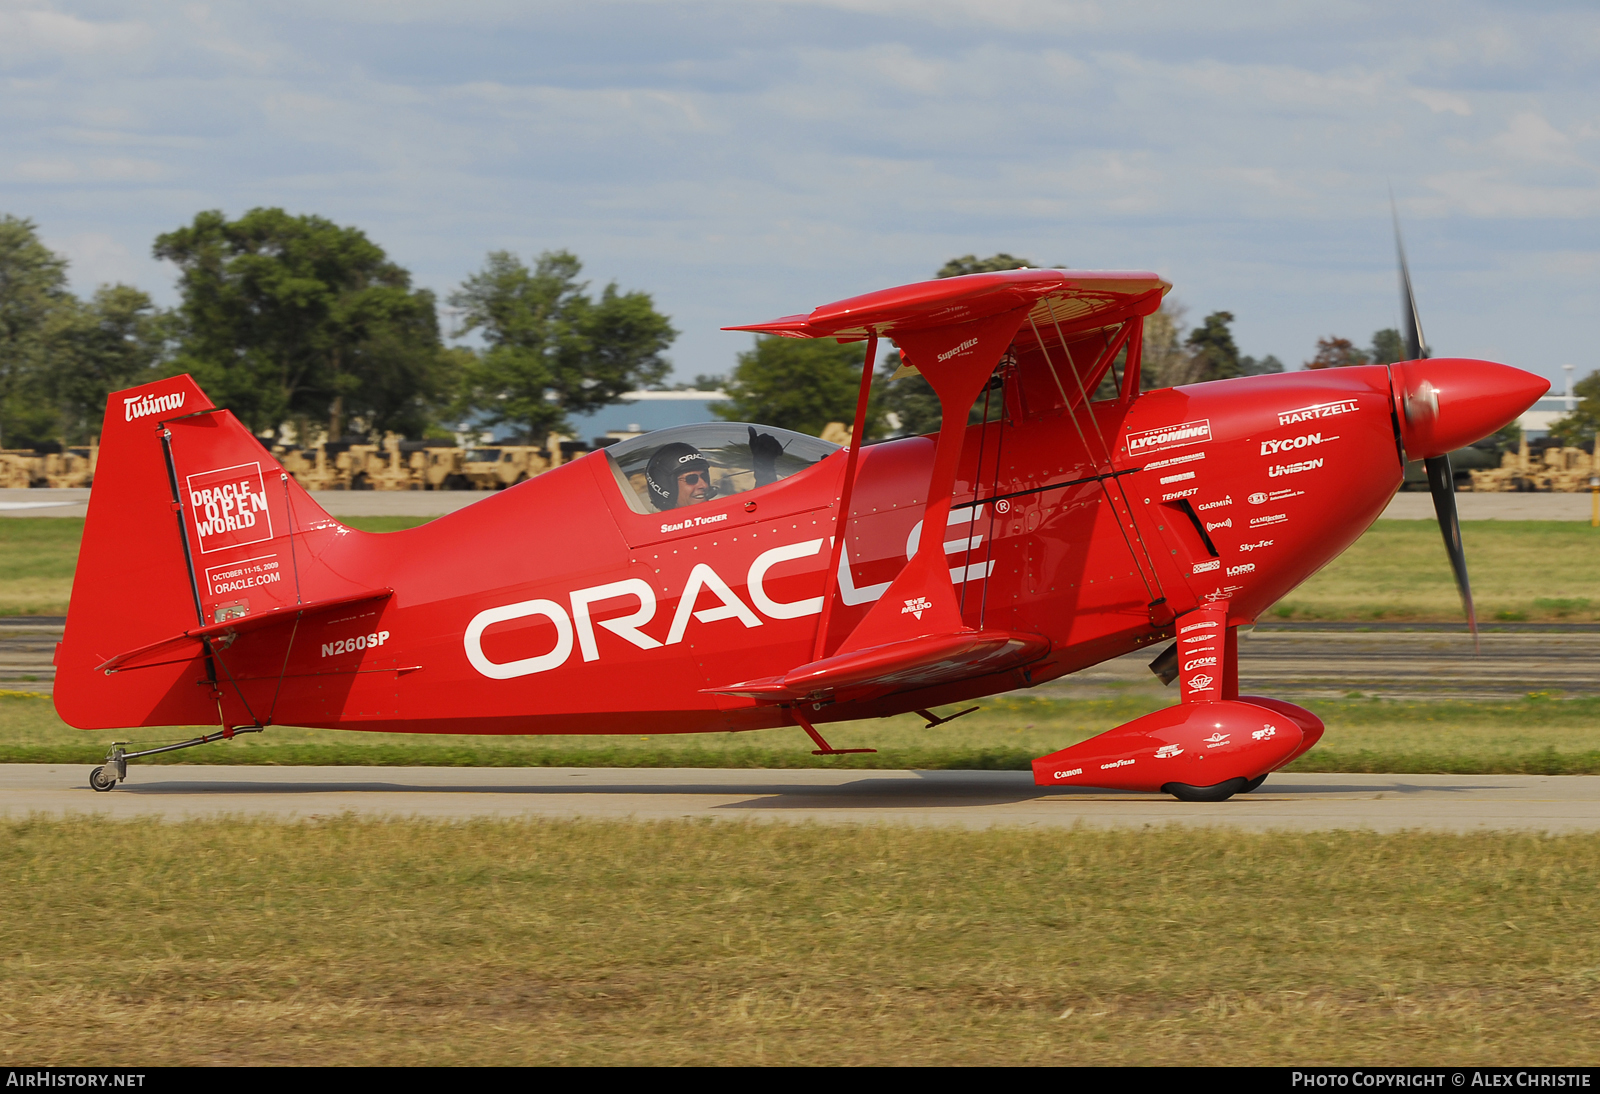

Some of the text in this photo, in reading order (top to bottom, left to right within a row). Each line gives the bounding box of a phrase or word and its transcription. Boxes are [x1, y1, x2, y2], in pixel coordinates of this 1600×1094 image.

[937, 337, 978, 362] Superflite
[123, 391, 185, 422] Tutima
[1279, 403, 1359, 425] HARTZELL
[1130, 425, 1208, 449] LYCOMING
[1261, 432, 1321, 456] LYCON
[679, 453, 705, 463] ORAC
[1268, 458, 1323, 478] UNISON
[191, 481, 251, 507] ORACLE
[1162, 487, 1199, 501] TEMPEST
[204, 491, 267, 521] OPEN
[1198, 499, 1233, 511] GARMIN
[197, 511, 256, 537] WORLD
[684, 519, 694, 528] D.
[1239, 540, 1274, 552] Sky-Tec
[212, 561, 279, 581] OCTOBER 11-15, 2009
[1226, 563, 1256, 575] LORD
[215, 572, 281, 594] ORACLE.COM
[463, 503, 996, 680] ORACLE
[321, 630, 390, 658] N260SP
[1184, 656, 1217, 671] Grove
[1053, 768, 1083, 779] Canon
[1100, 759, 1135, 770] GOODYEAR
